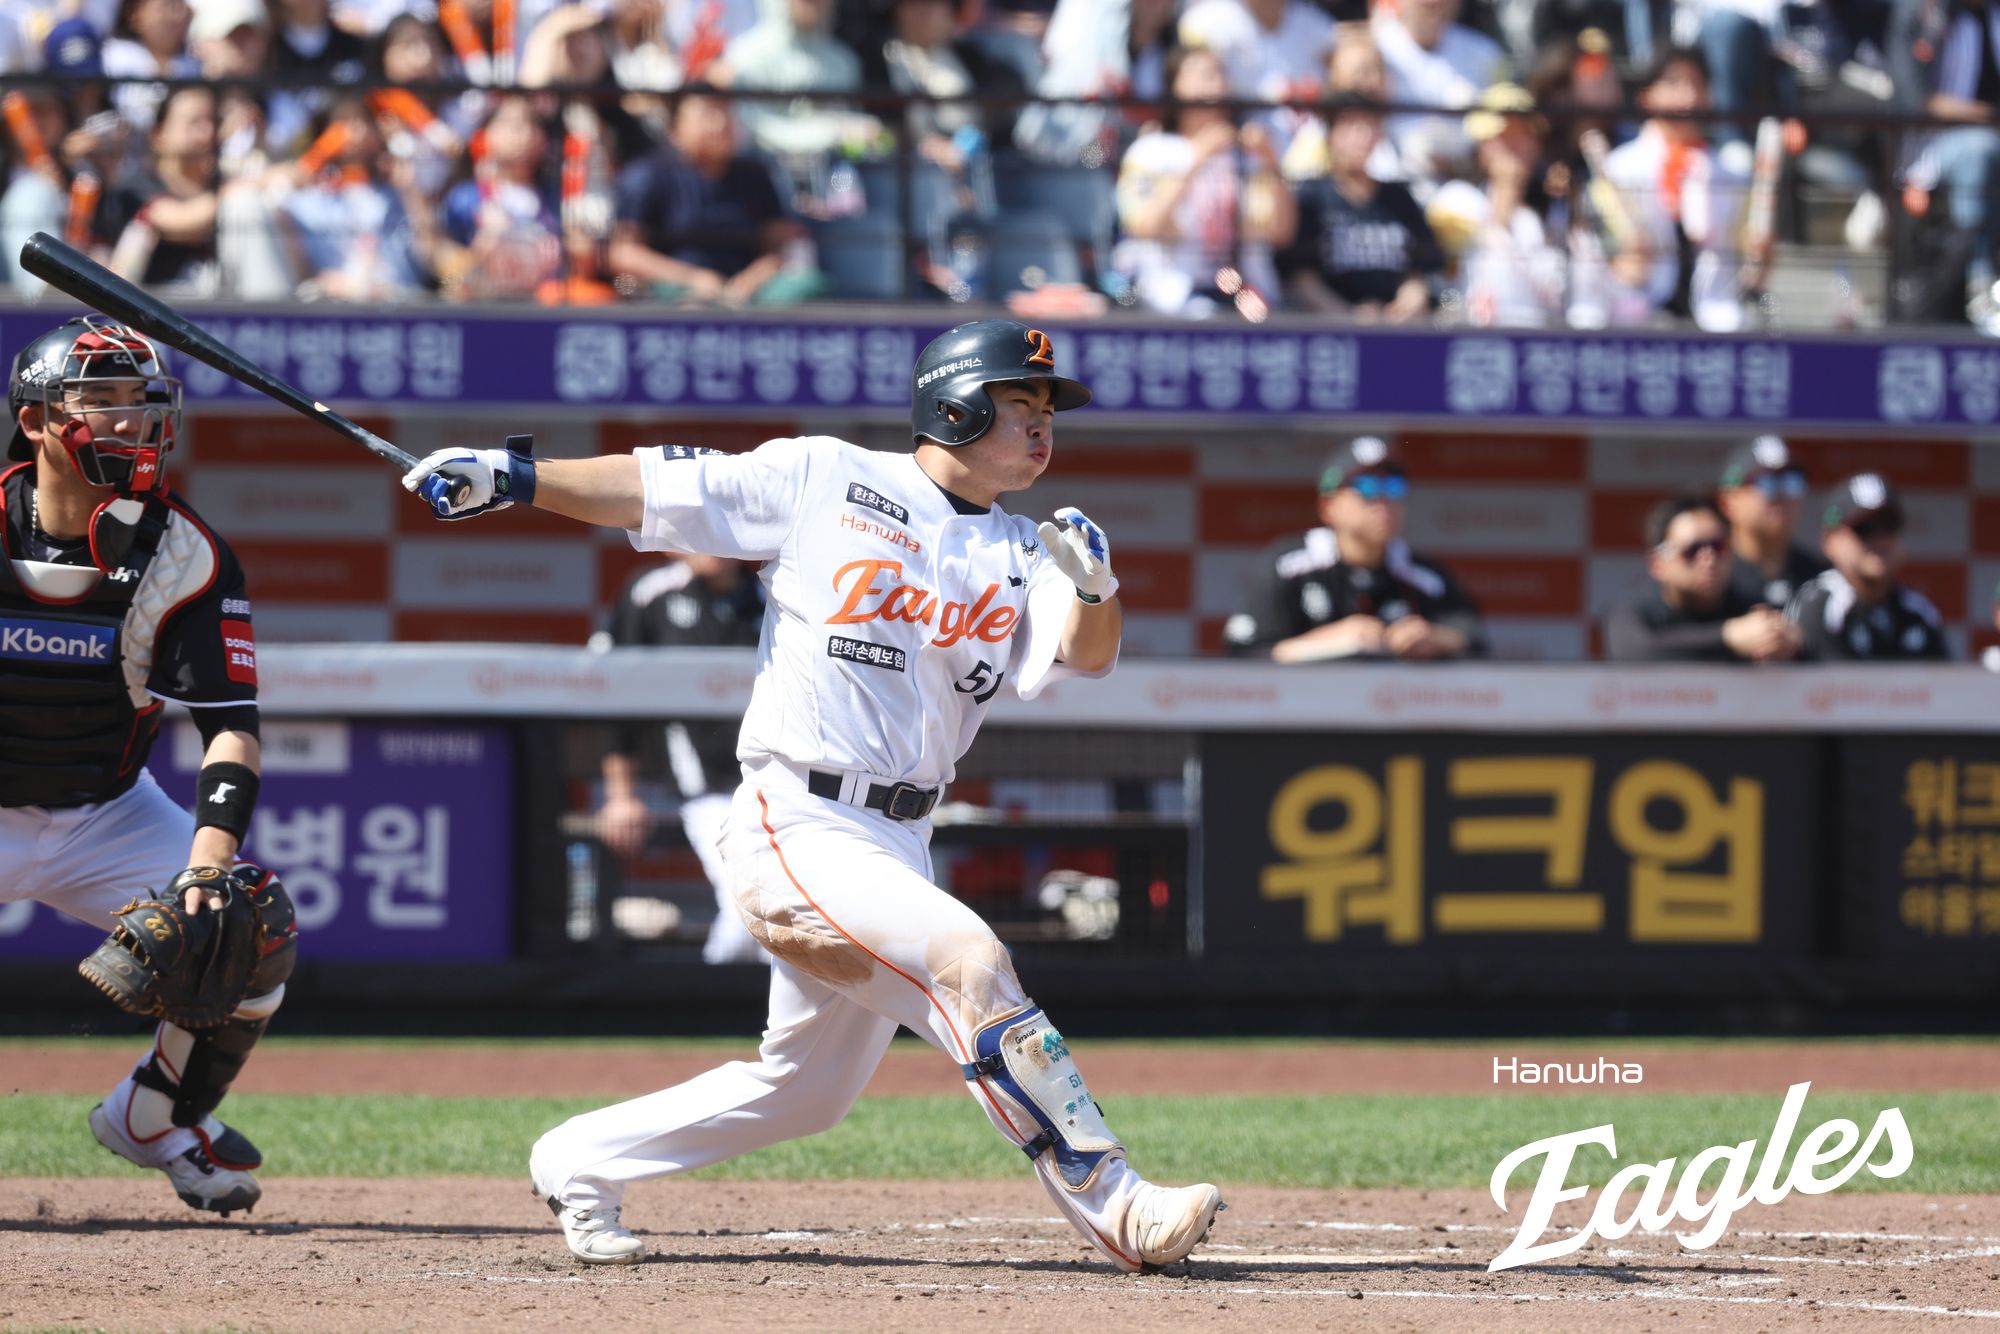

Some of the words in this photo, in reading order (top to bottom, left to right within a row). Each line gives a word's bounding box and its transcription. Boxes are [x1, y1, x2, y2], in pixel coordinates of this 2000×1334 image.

[853, 486, 905, 519] 한화생명
[840, 513, 921, 553] Hanwha
[824, 559, 1026, 648] Eagle
[2, 627, 108, 659] Kbank
[829, 637, 905, 670] 한화손해보험
[1261, 755, 1764, 945] 워크업
